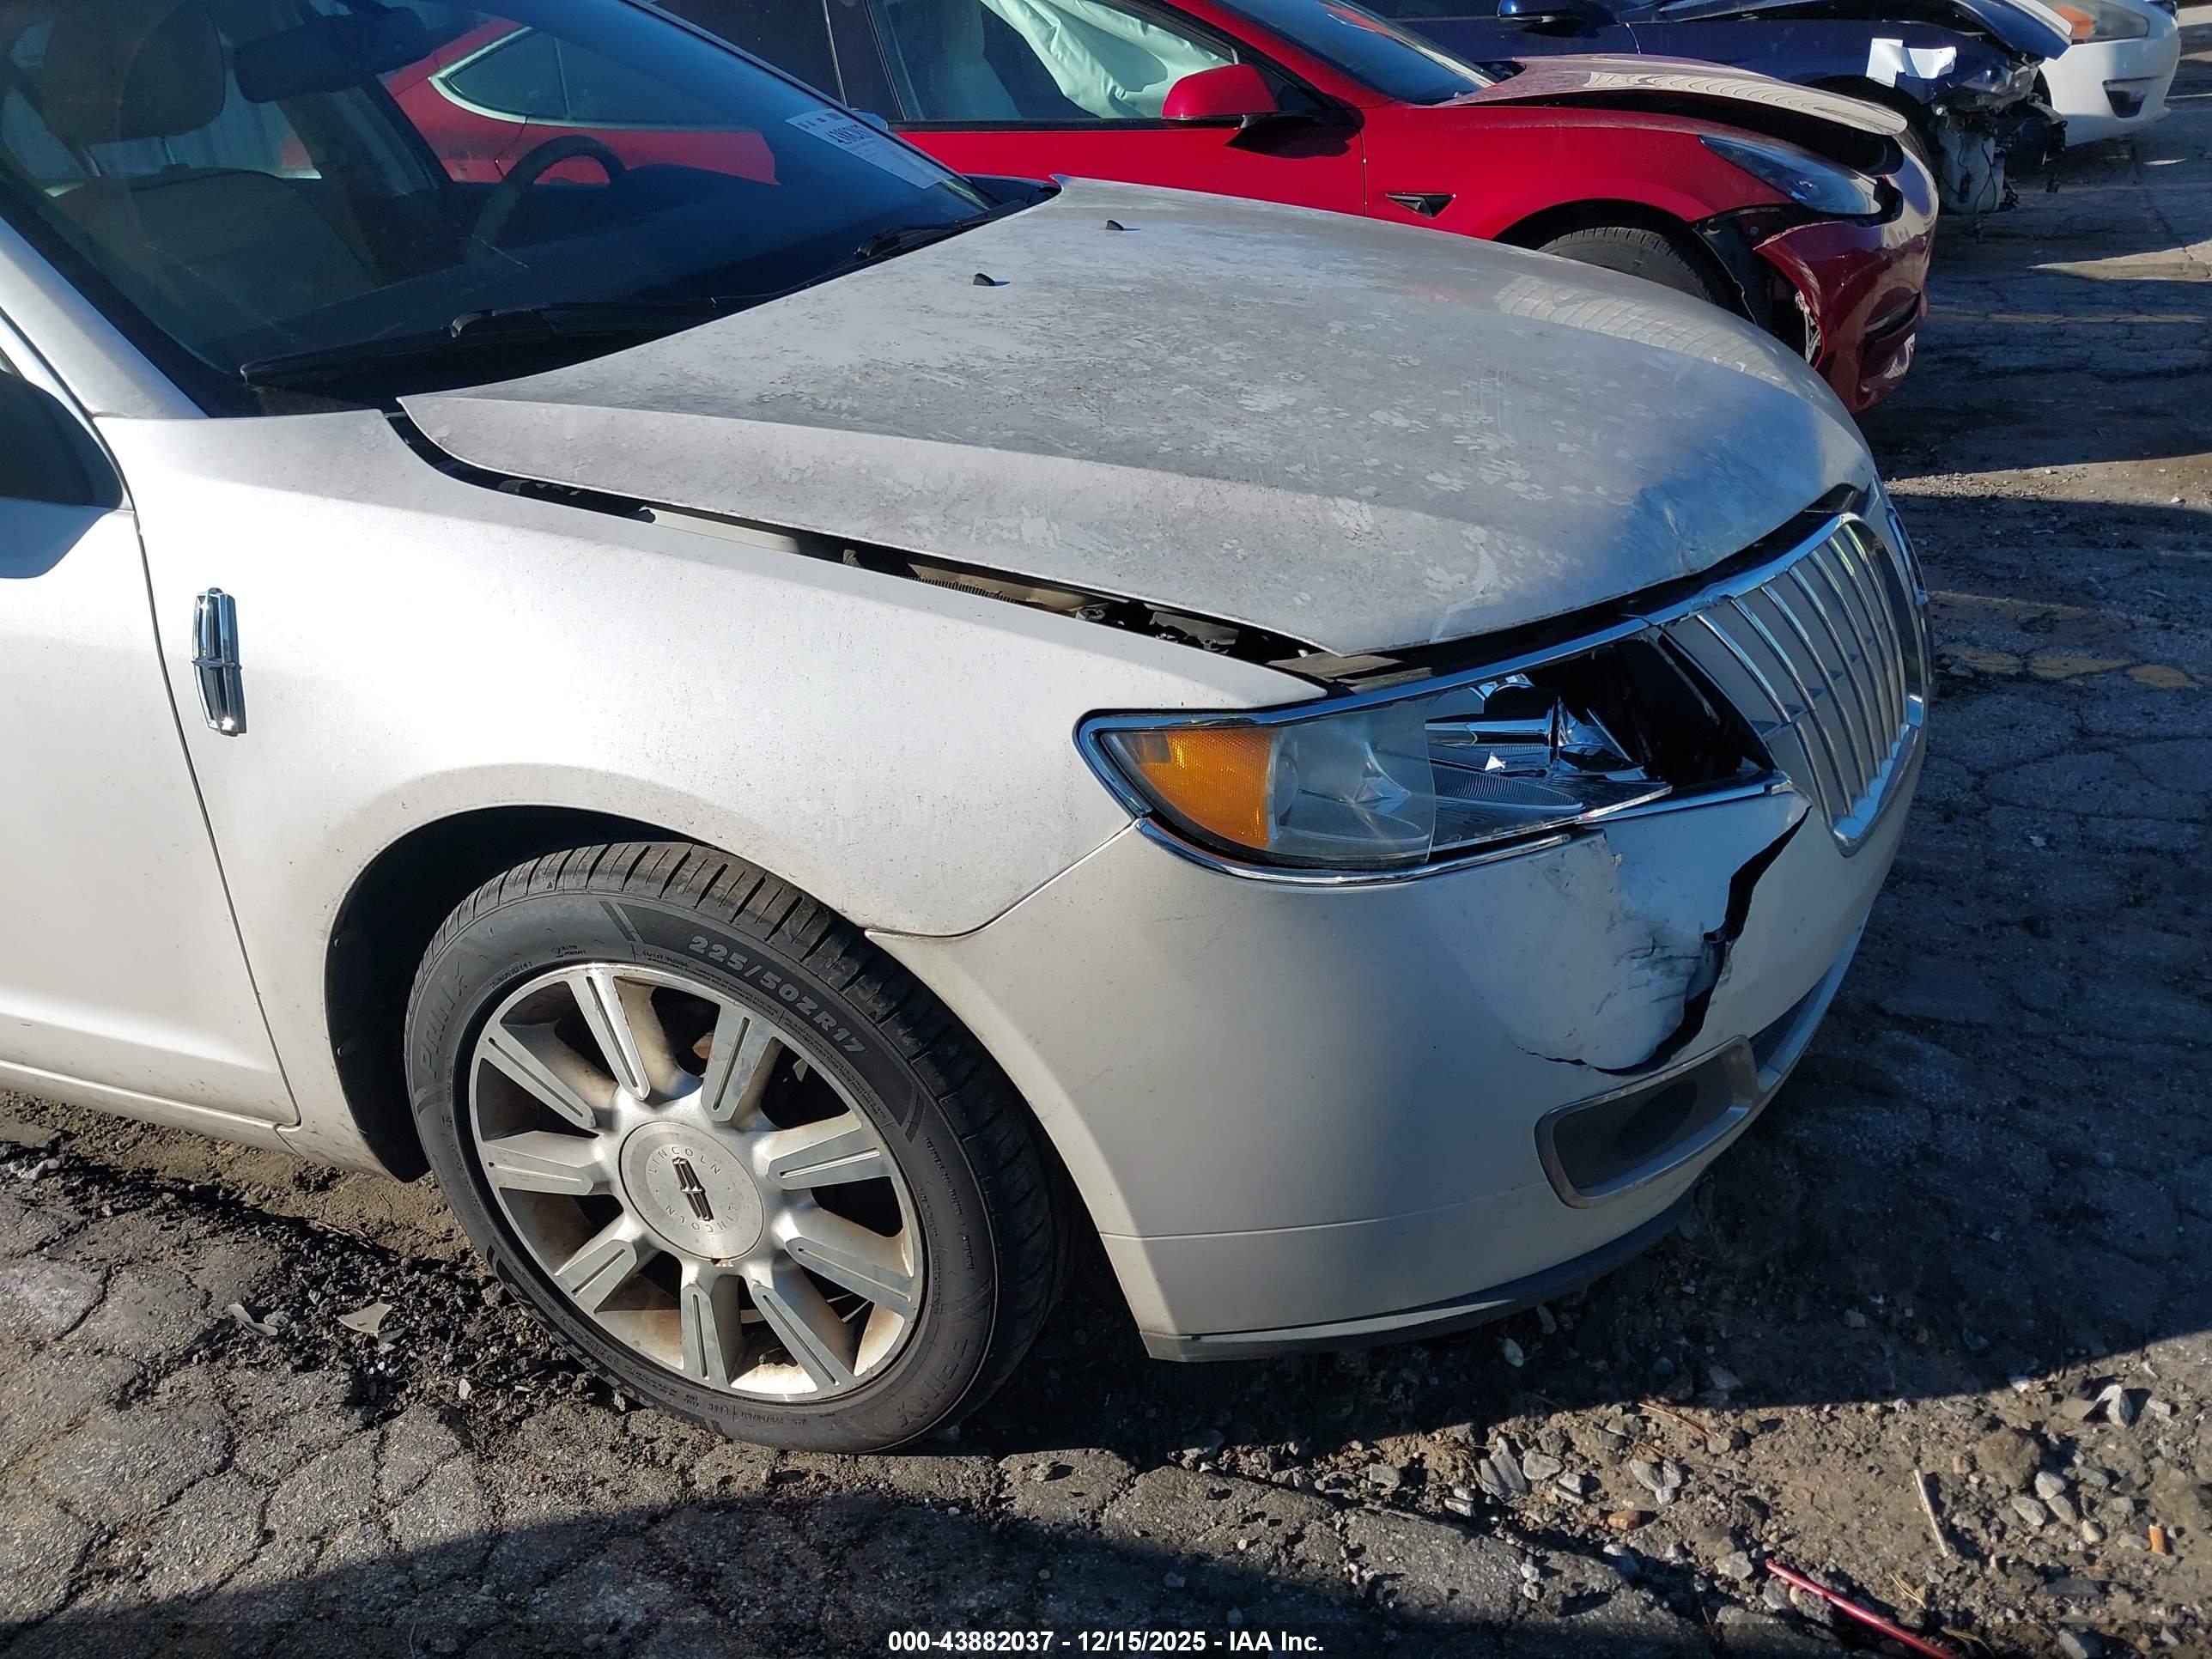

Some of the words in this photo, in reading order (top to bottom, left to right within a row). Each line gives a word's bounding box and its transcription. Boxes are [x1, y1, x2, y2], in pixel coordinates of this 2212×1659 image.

[688, 933, 866, 1053] 225/50ZR17
[648, 1146, 721, 1175] LINCOLN
[665, 1205, 738, 1234] LINCOLN
